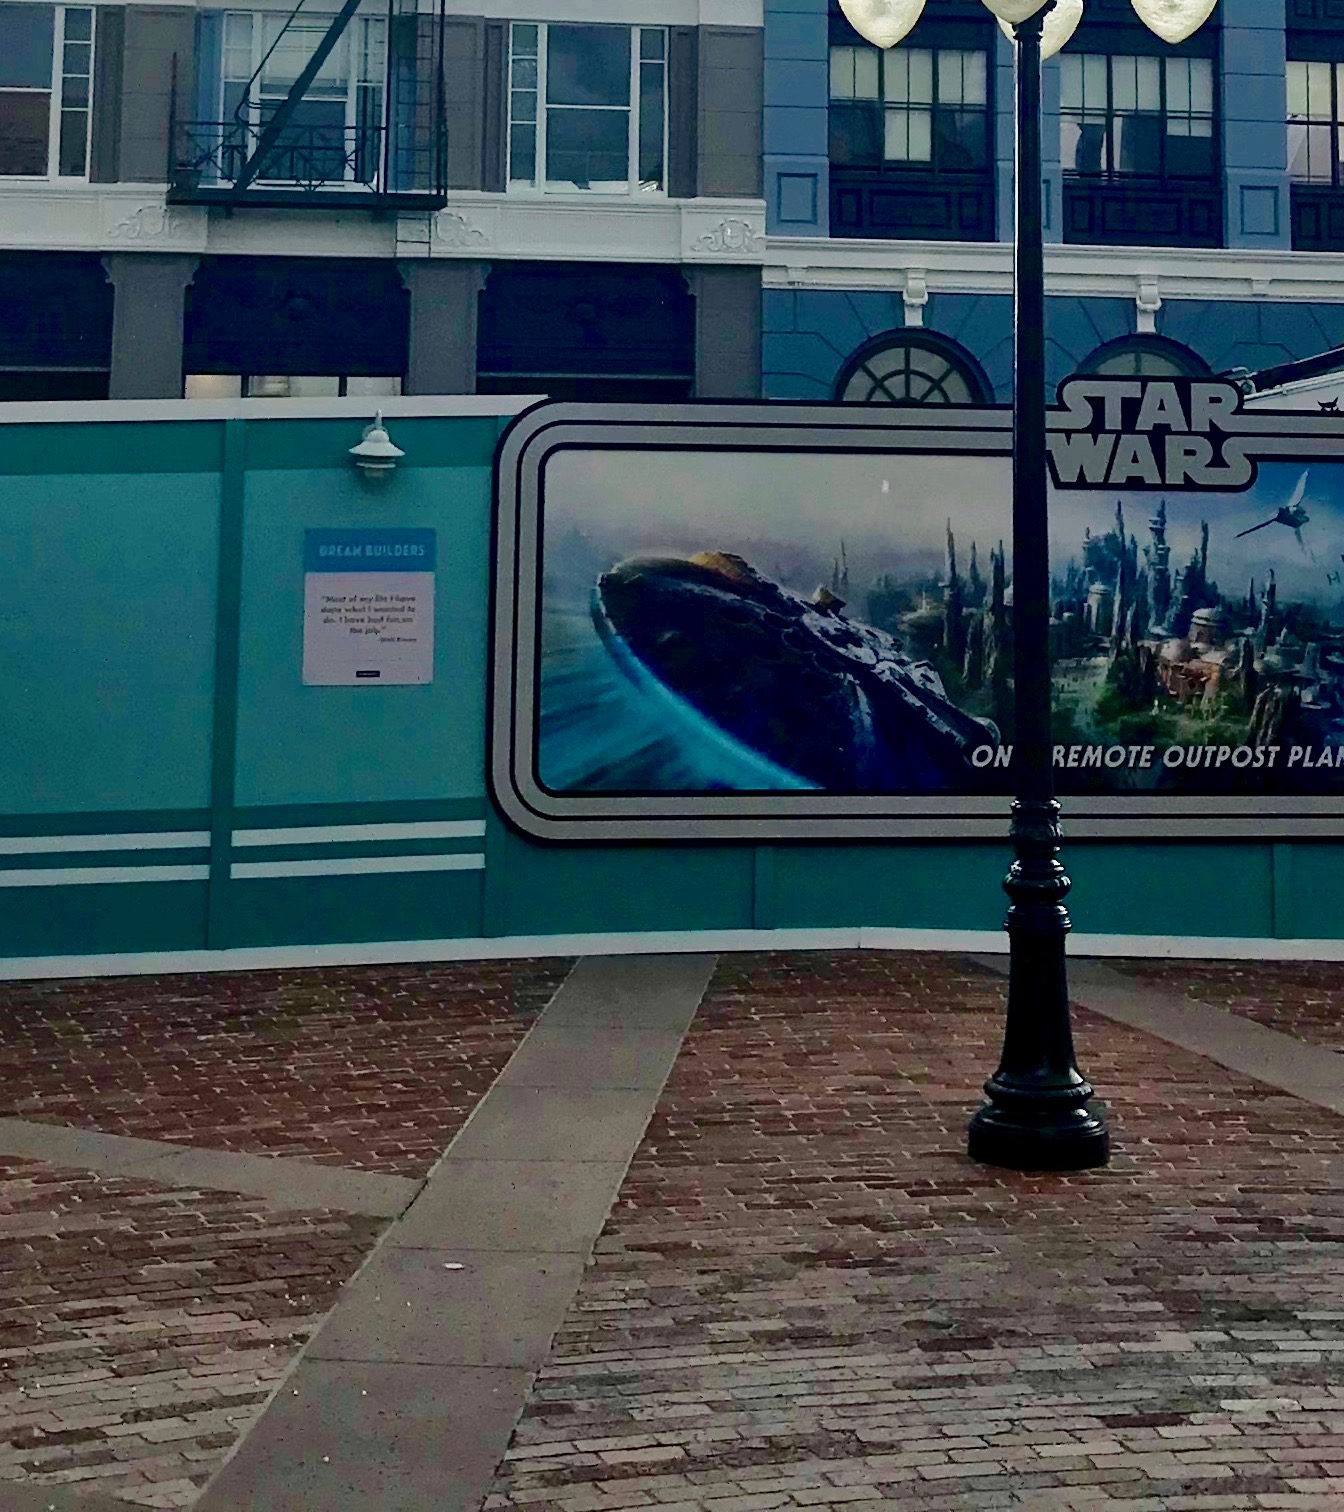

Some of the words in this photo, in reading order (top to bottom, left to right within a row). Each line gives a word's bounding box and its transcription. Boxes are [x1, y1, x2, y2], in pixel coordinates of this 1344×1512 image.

[1050, 380, 1244, 431] STAR
[1046, 433, 1253, 486] WARS
[319, 544, 362, 557] DREAM
[365, 544, 425, 557] BUILDERS
[971, 744, 1014, 768] ON
[1052, 744, 1155, 768] REMOTE
[1163, 744, 1280, 768] OUTPOST
